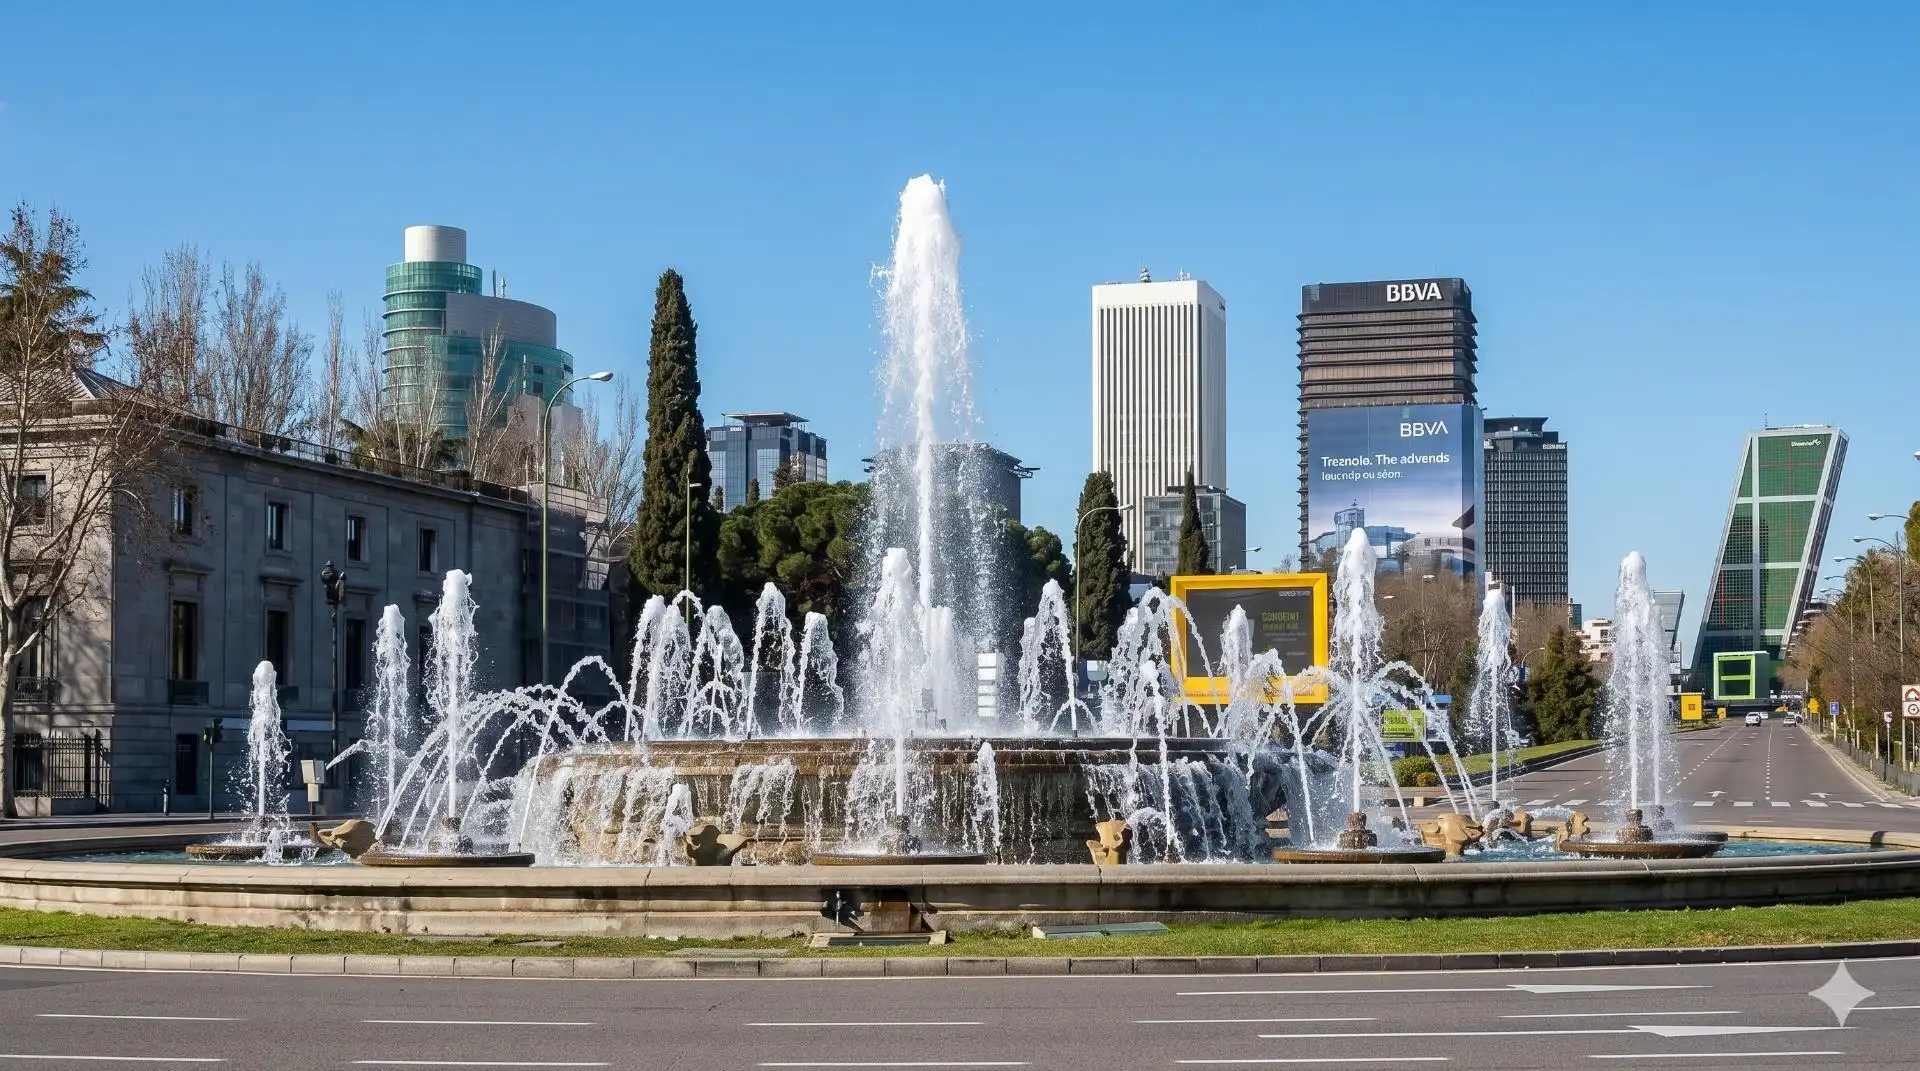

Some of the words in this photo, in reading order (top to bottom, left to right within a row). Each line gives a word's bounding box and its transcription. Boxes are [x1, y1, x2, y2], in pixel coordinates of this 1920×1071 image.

[1386, 282, 1443, 303] BBVA
[1400, 420, 1449, 438] BBVA
[1375, 453, 1398, 465] The
[1400, 452, 1450, 464] advends
[1362, 471, 1375, 480] ou
